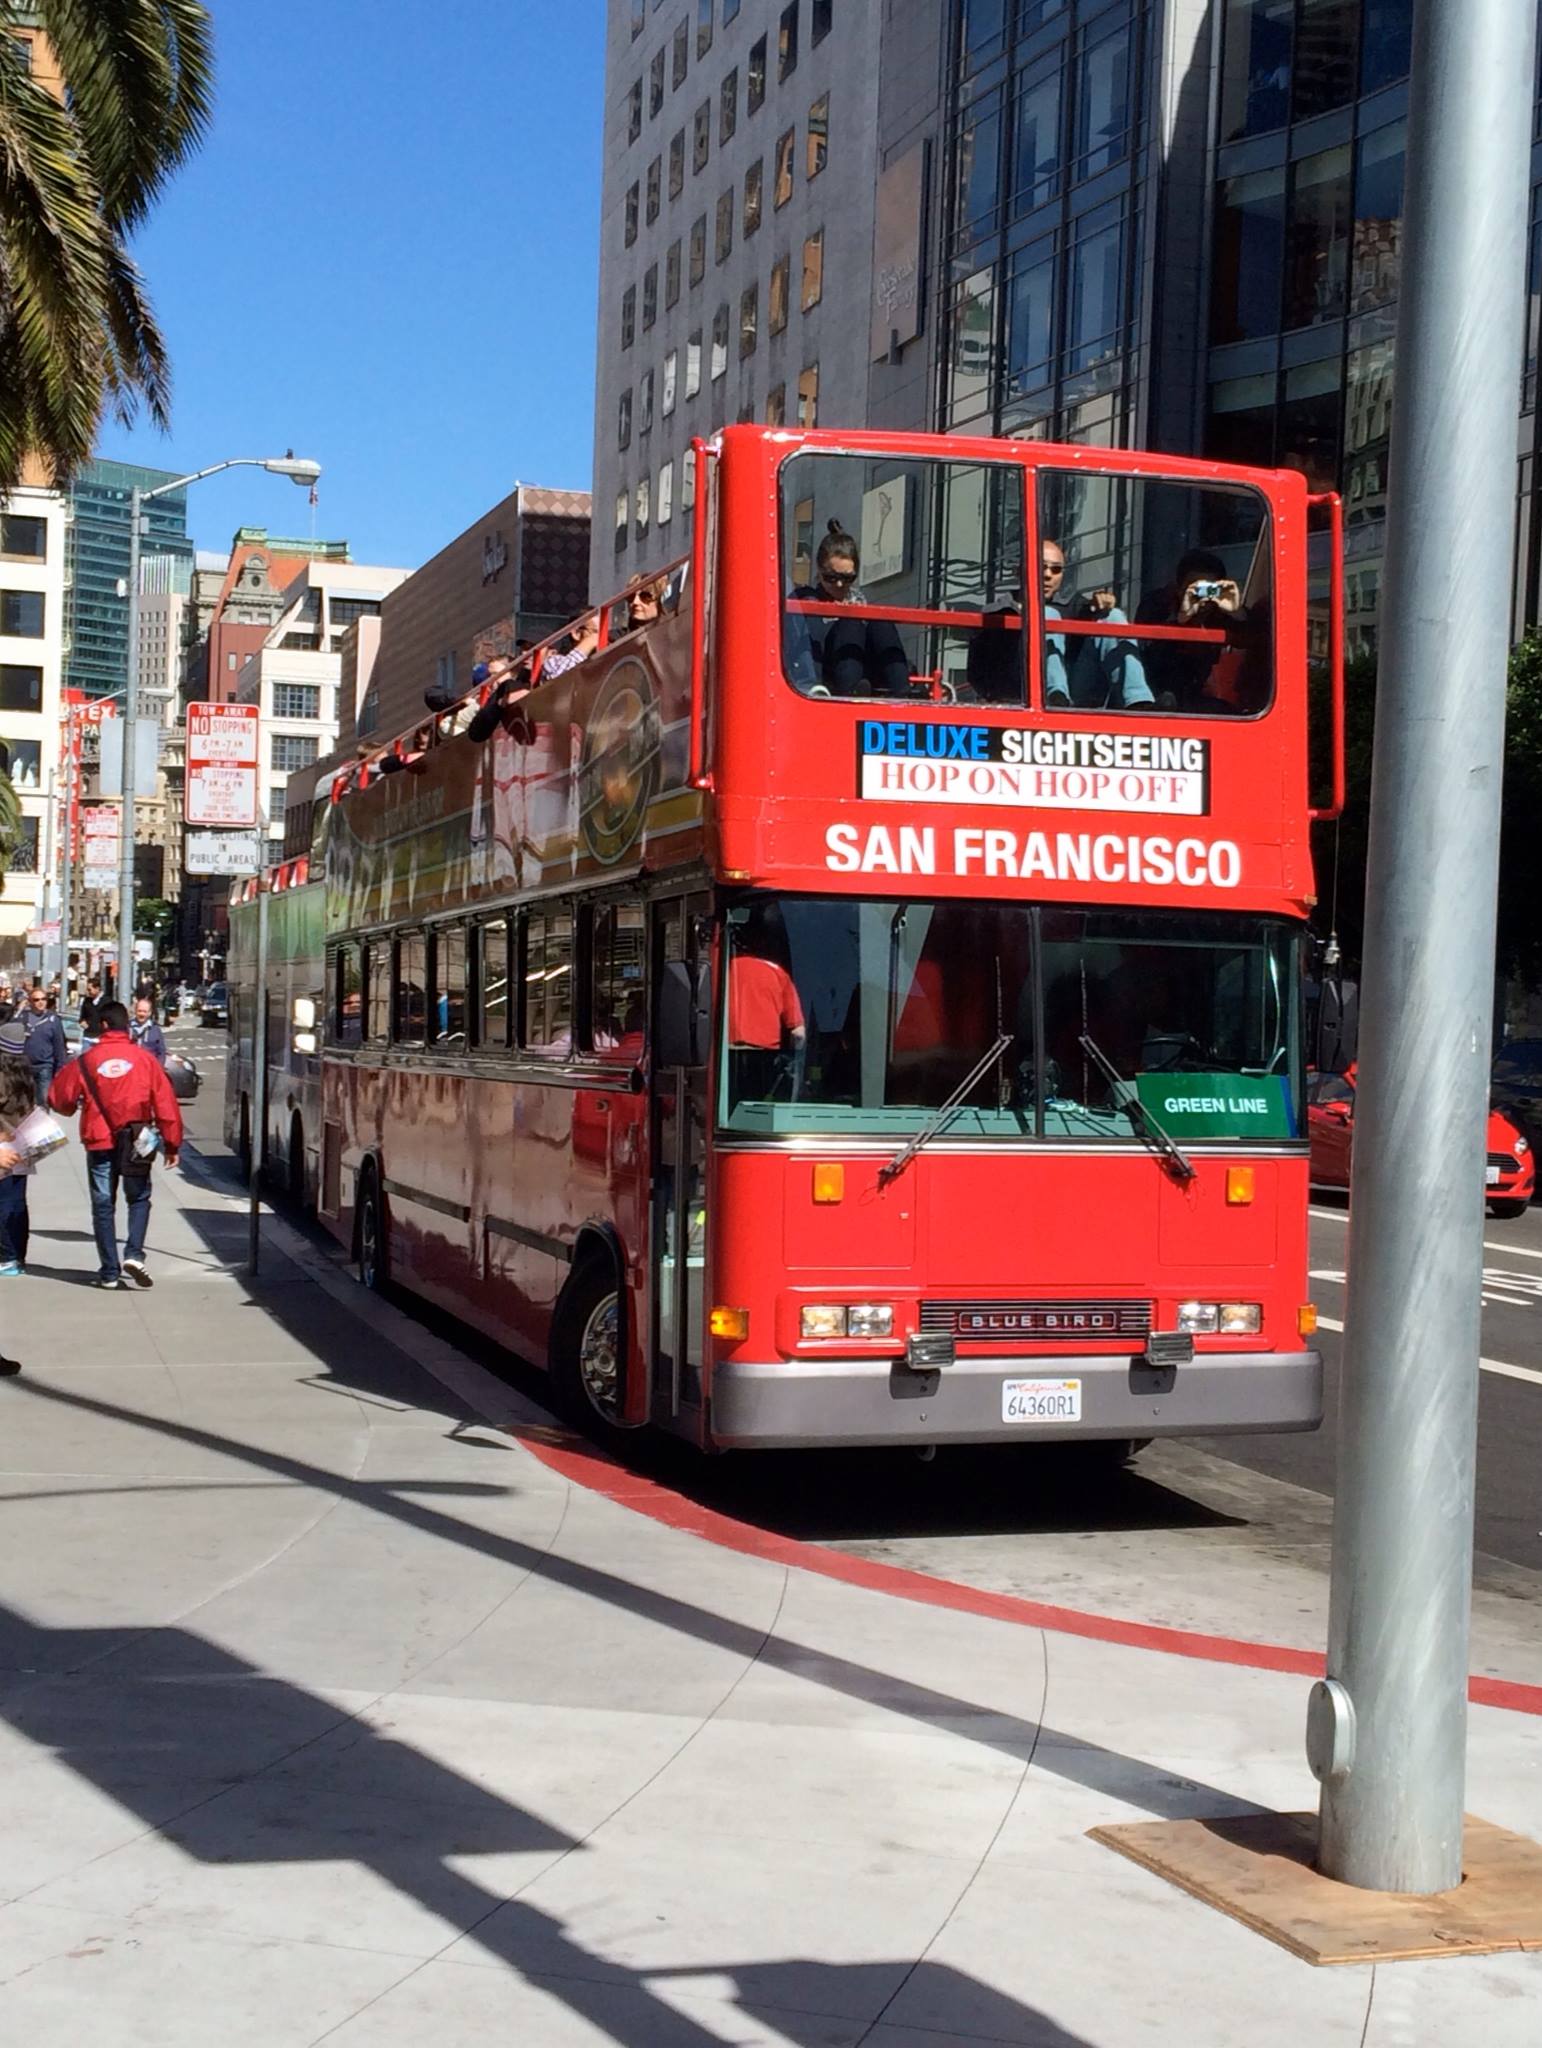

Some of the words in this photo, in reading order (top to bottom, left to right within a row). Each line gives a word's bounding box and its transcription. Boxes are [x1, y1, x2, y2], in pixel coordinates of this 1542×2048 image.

[192, 717, 210, 735] NO
[213, 719, 253, 735] STOPPING
[863, 722, 988, 760] DELUXE
[1001, 730, 1203, 771] SIGHTSEEING
[880, 762, 960, 792] HOP
[969, 767, 1020, 796] ON
[1035, 771, 1110, 800] HOP
[1119, 774, 1188, 803] OFF
[218, 844, 227, 853] IN
[825, 824, 935, 875] SAN
[954, 829, 1242, 888] FRANCISCO
[190, 853, 220, 864] PUBLIC
[228, 854, 256, 865] AREAS
[1164, 1098, 1226, 1113] GREEN
[1228, 1098, 1268, 1113] LINE
[972, 1315, 1032, 1327] BLUE
[1046, 1315, 1104, 1327] BIRD
